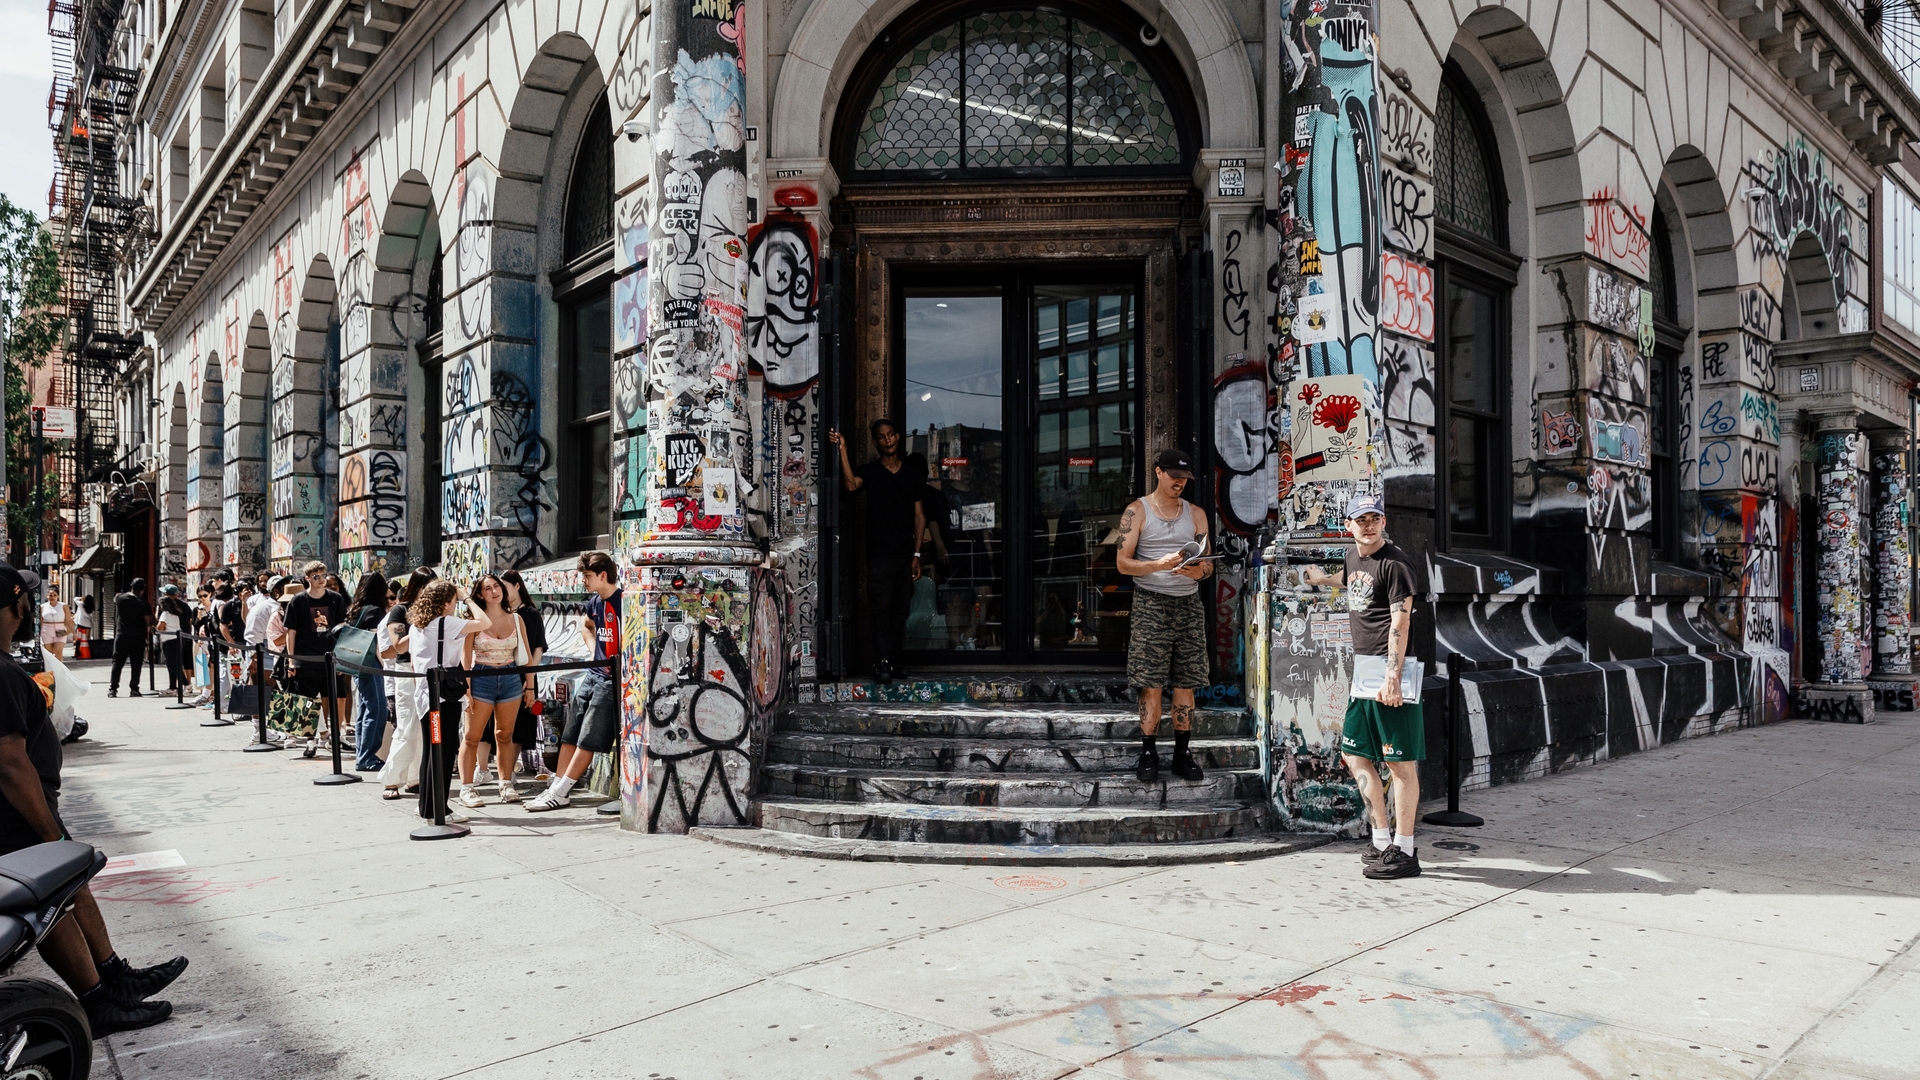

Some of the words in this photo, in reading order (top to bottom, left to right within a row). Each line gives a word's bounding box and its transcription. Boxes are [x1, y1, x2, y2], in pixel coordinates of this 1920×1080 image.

[1295, 139, 1312, 149] YD4
[1221, 160, 1245, 168] DELK
[778, 170, 801, 178] DELK
[665, 184, 699, 195] COMA
[1220, 188, 1244, 196] YD43
[1301, 240, 1318, 262] INF
[665, 301, 698, 314] FRIENDS
[680, 319, 698, 328] YORK
[1298, 384, 1321, 398] PICK
[1314, 396, 1360, 424] DEMOCRACY
[671, 439, 698, 454] NYC
[943, 458, 967, 466] Supreme
[1069, 458, 1093, 466] Supreme
[597, 627, 613, 637] ATAR
[432, 712, 440, 742] Supreme
